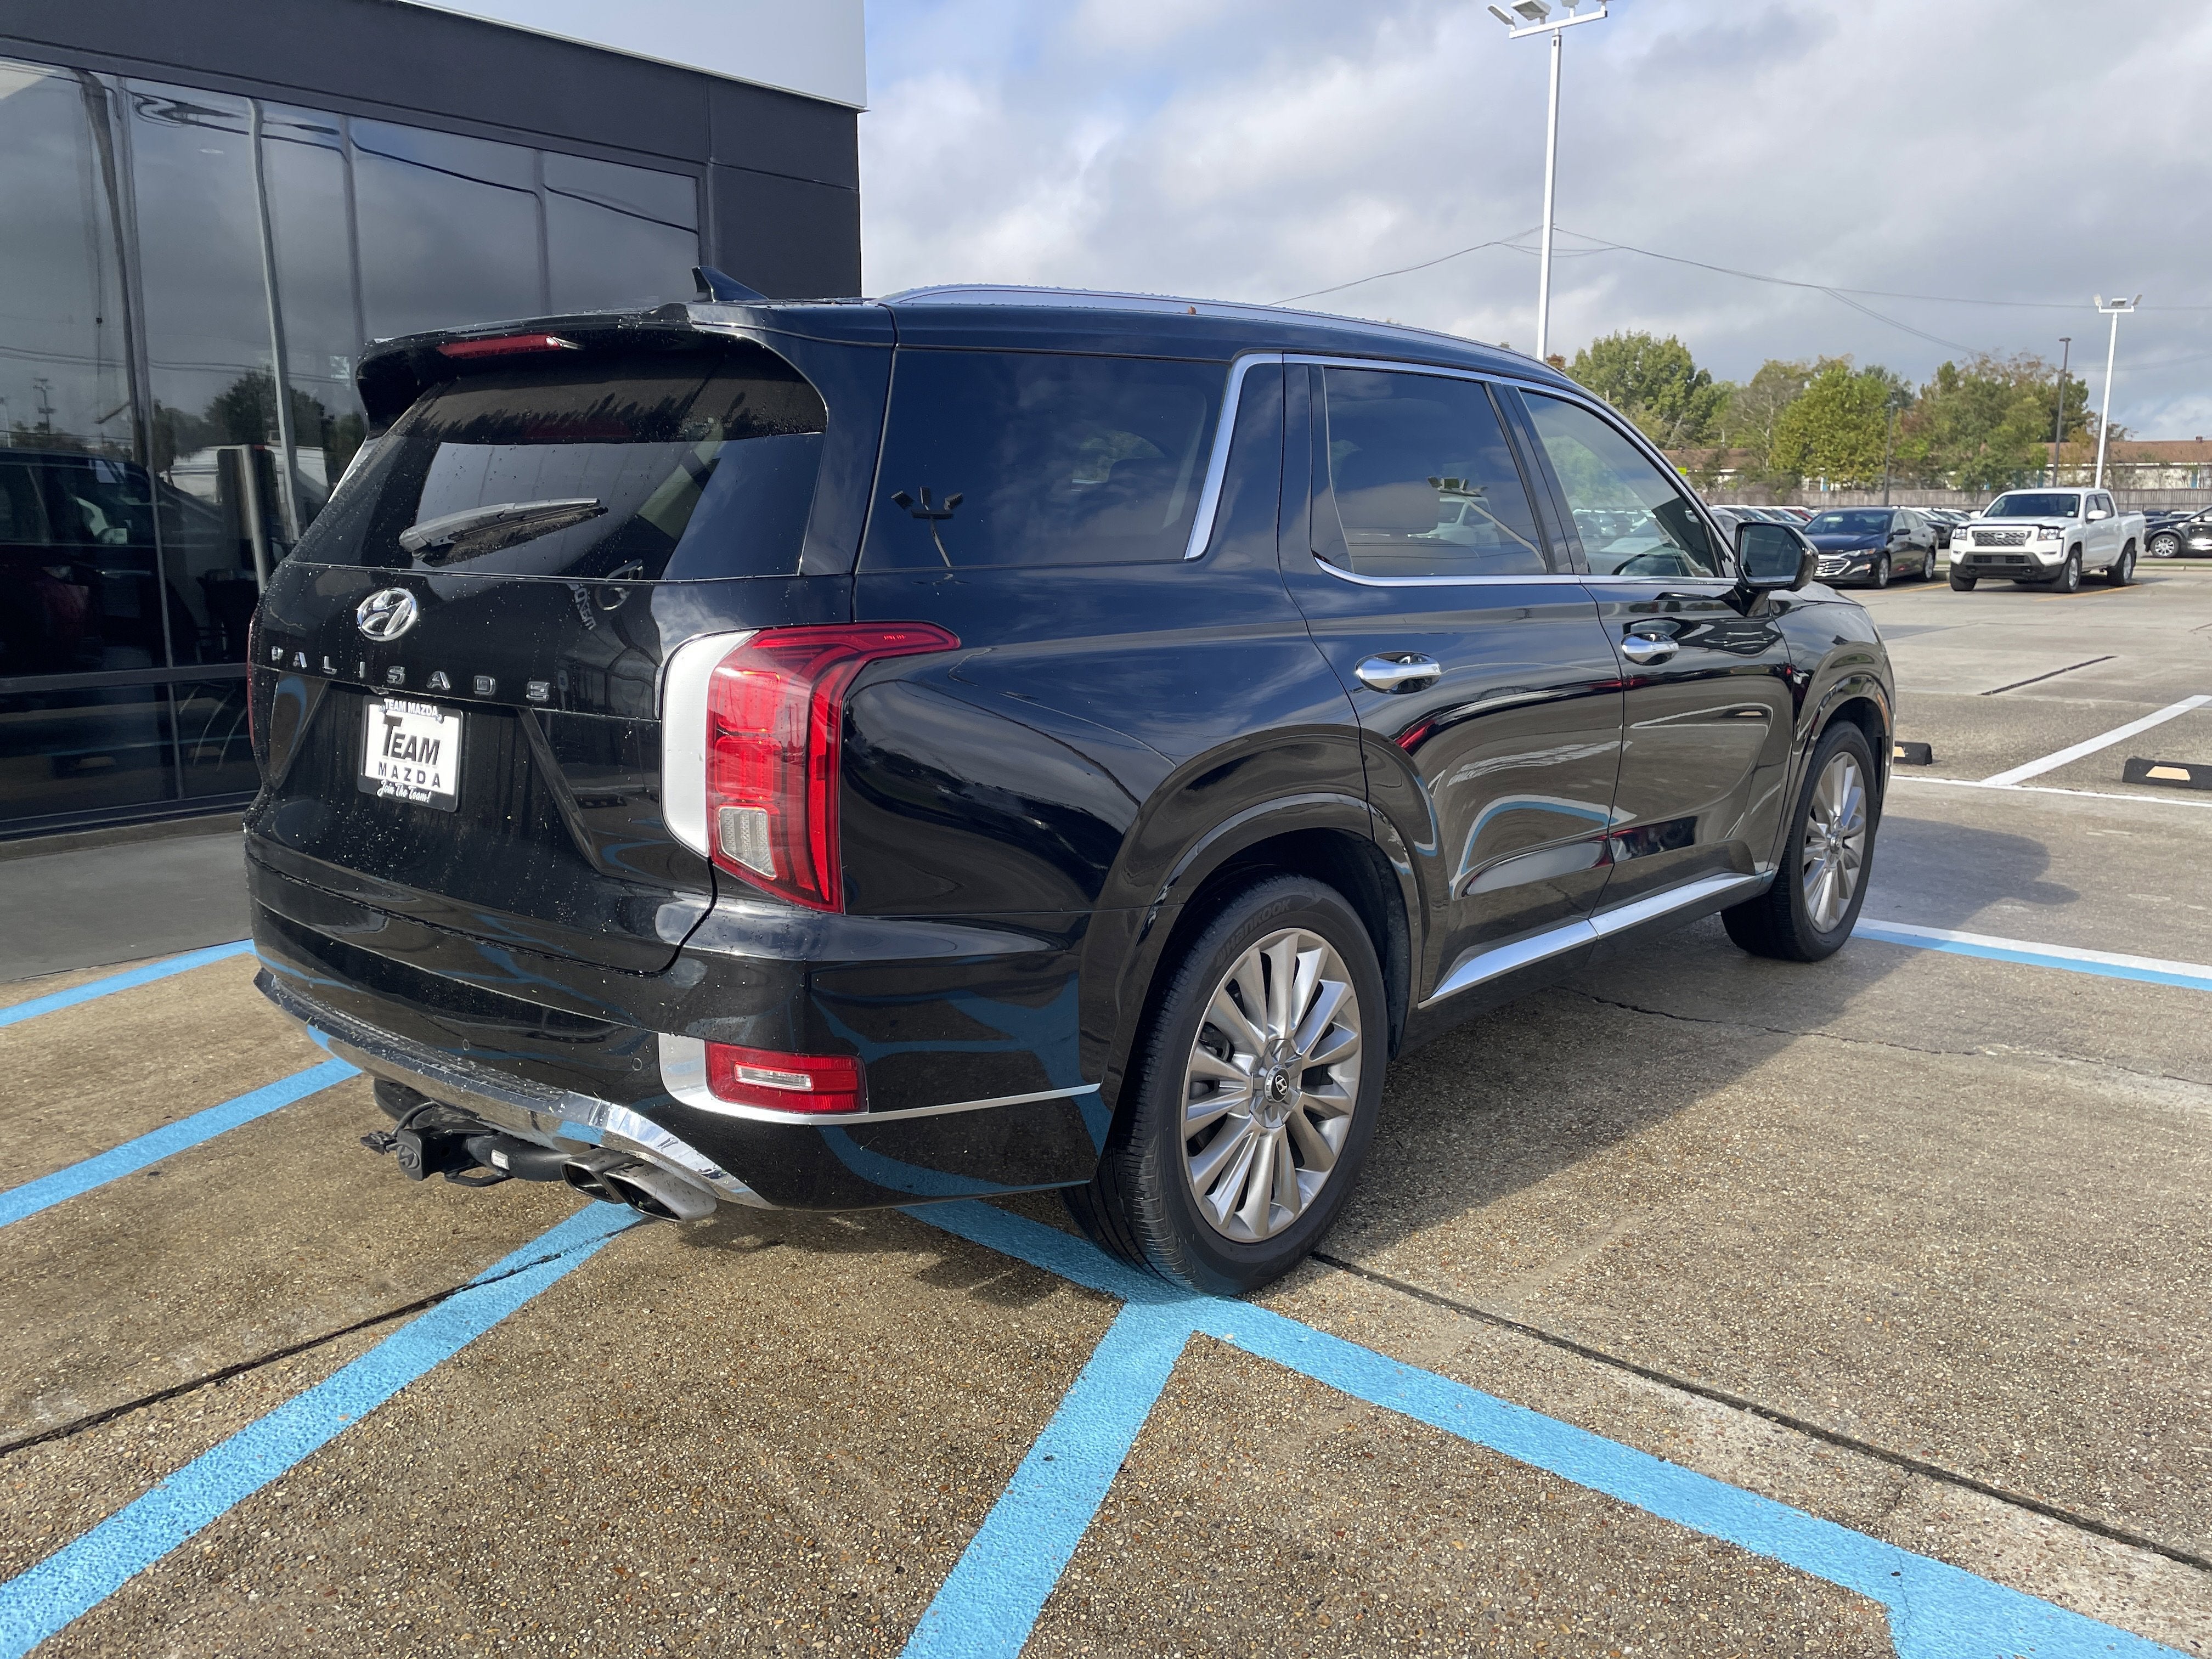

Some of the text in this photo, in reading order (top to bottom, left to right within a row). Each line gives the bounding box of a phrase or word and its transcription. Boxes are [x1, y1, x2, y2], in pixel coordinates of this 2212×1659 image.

[271, 646, 550, 701] PALISADE
[383, 698, 438, 717] TEAM MAZDA
[382, 714, 441, 766] TEAM
[378, 761, 441, 788] MAZDA
[376, 780, 432, 803] Join The Team!
